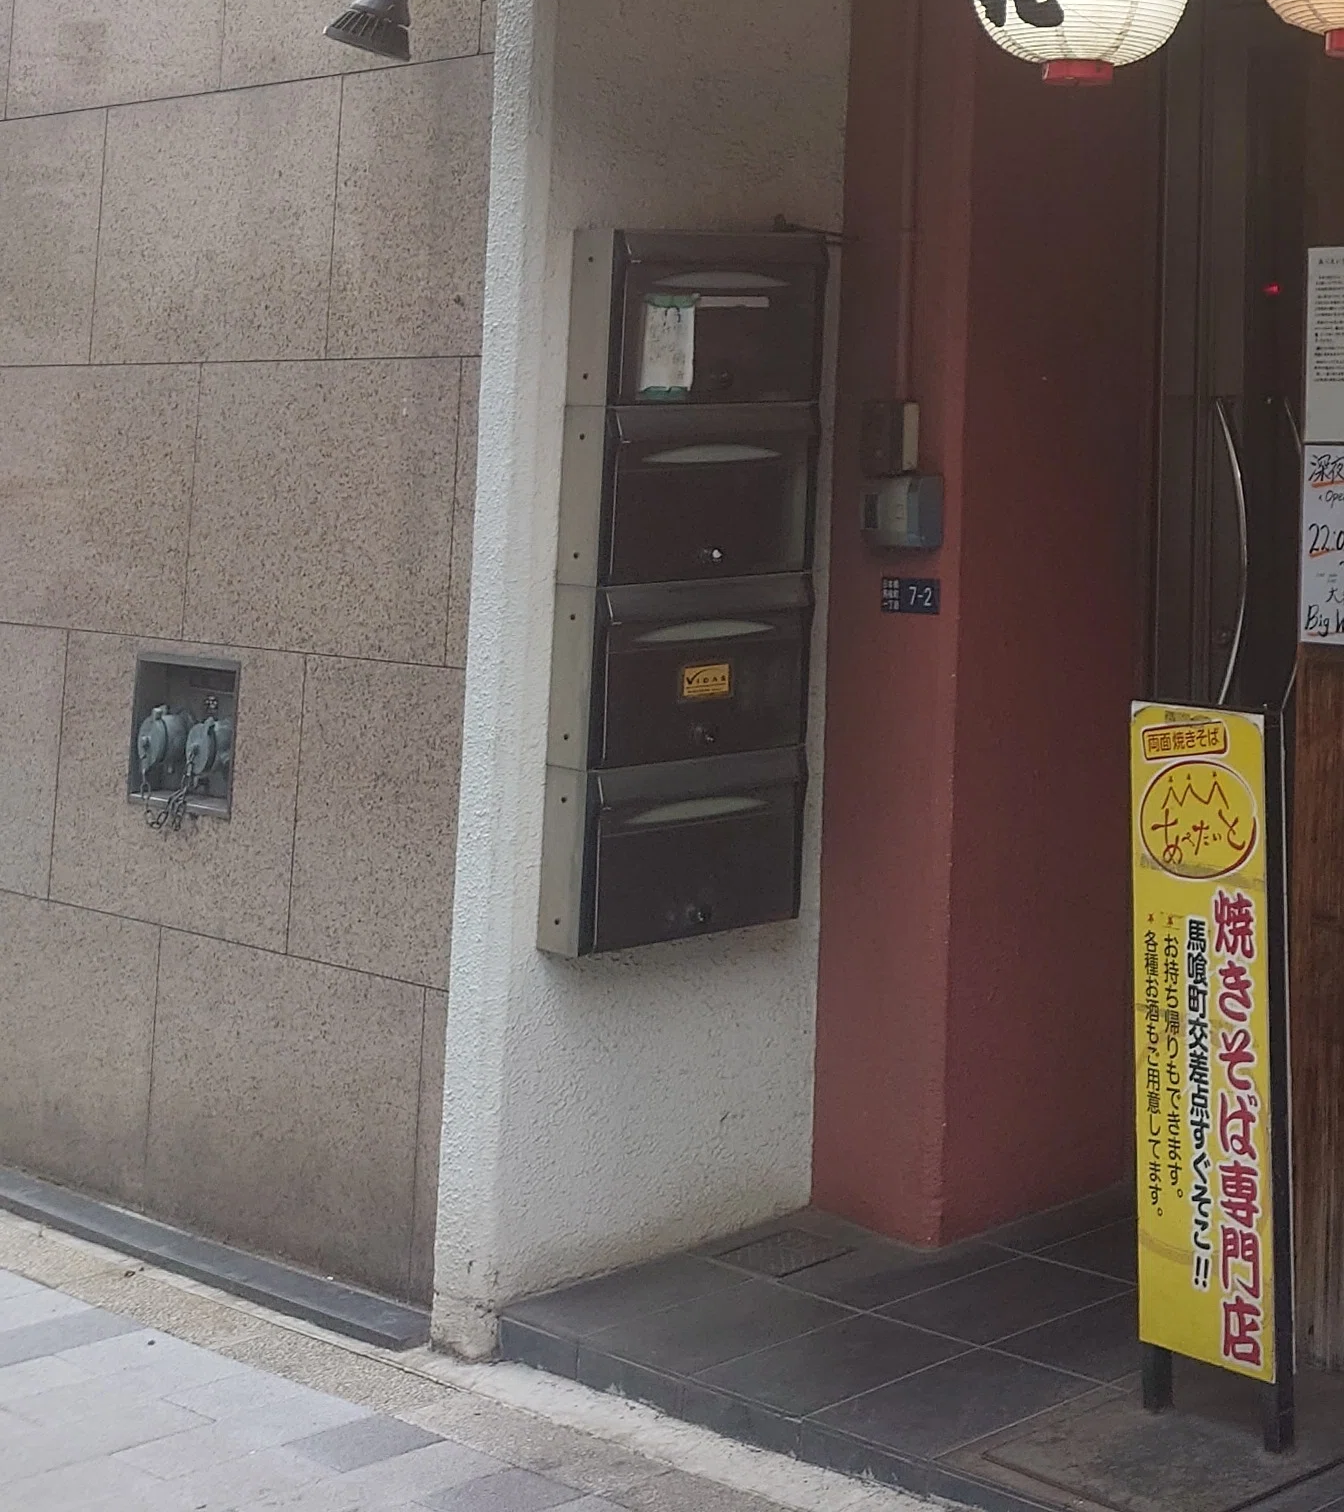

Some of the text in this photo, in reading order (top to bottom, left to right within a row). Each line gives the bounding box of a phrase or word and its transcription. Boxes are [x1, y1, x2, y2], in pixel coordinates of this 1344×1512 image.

[909, 586, 932, 606] 7-2
[1305, 605, 1329, 637] Big
[1148, 729, 1220, 753] 両面焼きそば
[1151, 808, 1246, 865] あぺたいと
[1164, 933, 1185, 1199] お持ち帰りもできます。
[1214, 889, 1262, 1367] 焼きそば専門店
